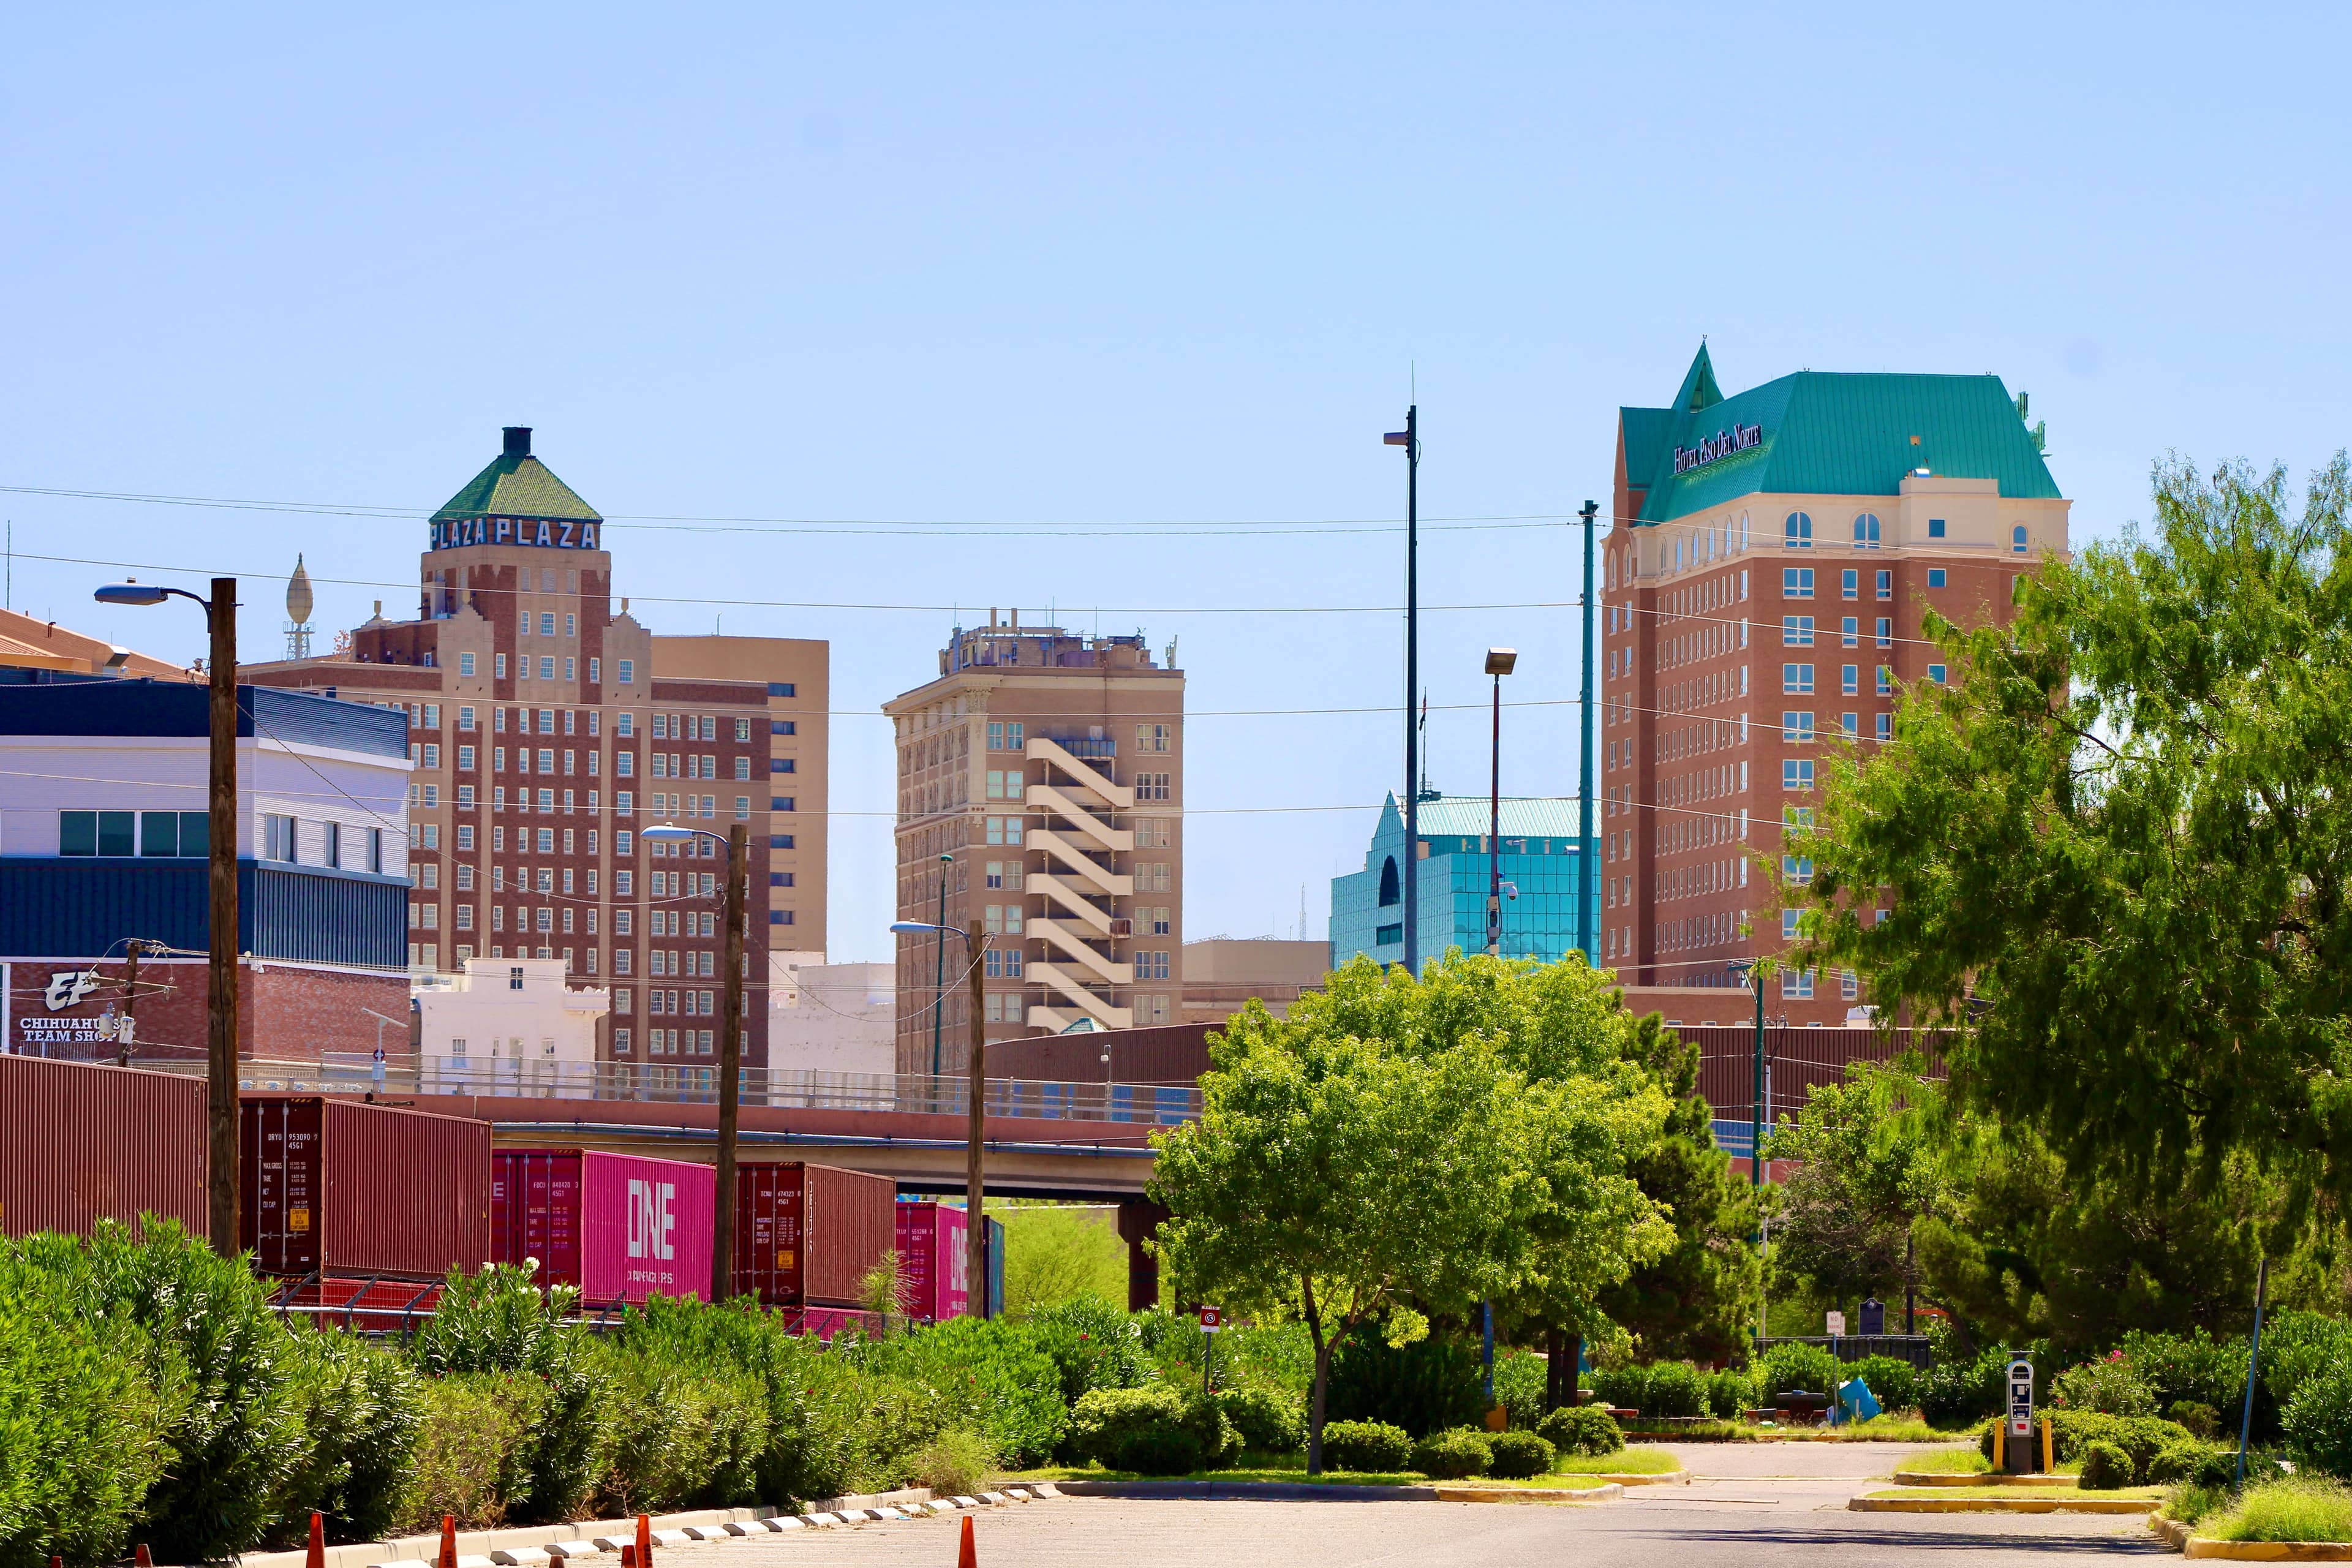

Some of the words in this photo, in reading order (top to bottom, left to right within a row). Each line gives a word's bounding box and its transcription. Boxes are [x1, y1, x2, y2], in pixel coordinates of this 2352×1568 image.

[1674, 447, 1698, 473] HOTEL
[1699, 437, 1716, 464] PASO
[1717, 431, 1732, 458] DEL
[1733, 423, 1760, 451] NORTE
[430, 518, 484, 549] PLAZA
[495, 518, 597, 549] PLAZA
[20, 1018, 121, 1030] CHIHUAHUS
[24, 1030, 72, 1042] TEAM
[628, 1178, 674, 1261] ONE
